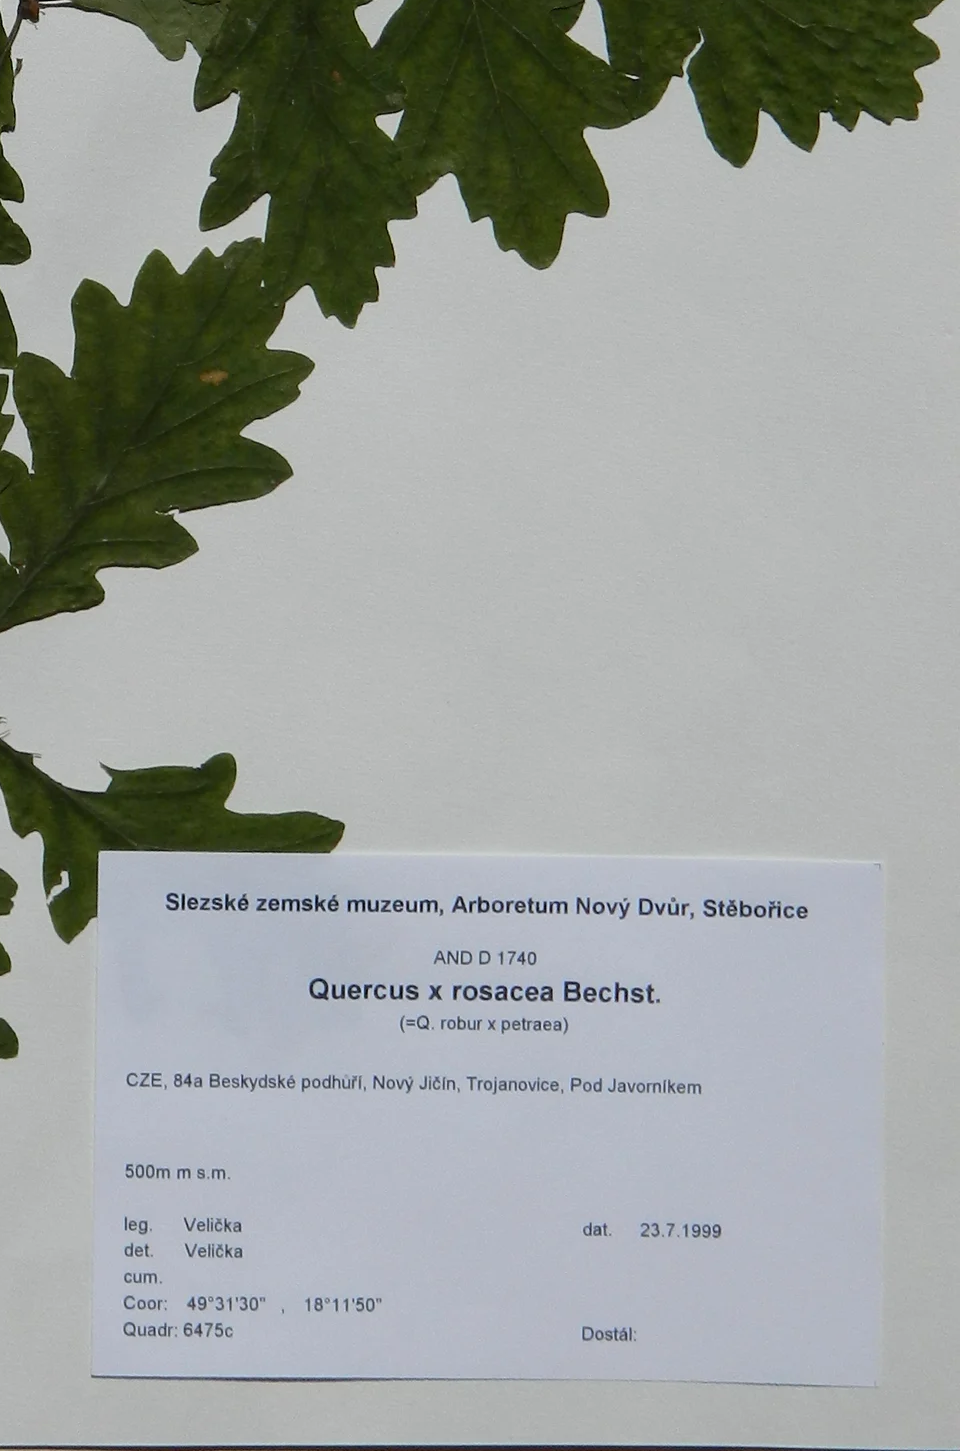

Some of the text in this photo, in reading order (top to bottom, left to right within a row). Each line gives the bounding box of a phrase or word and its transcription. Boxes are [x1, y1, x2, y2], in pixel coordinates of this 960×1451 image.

[165, 892, 809, 920] Slezské zemské muzeum, Arboretum Nový Dvůr, Stěbořice
[433, 950, 538, 966] AND D 1740
[308, 977, 662, 1005] Quercus x rosacea Bechst.
[399, 1014, 569, 1035] (=Q. robur x petraea)
[126, 1072, 168, 1090] CZE,
[173, 1072, 203, 1089] 84a
[209, 1073, 296, 1093] Beskydské
[372, 1075, 414, 1094] Nový
[418, 1075, 461, 1094] Jičín,
[466, 1076, 565, 1095] Trojanovice,
[570, 1077, 603, 1093] Pod
[607, 1078, 703, 1095] Javorníkem
[125, 1163, 232, 1180] 500m m s.m.
[124, 1216, 243, 1235] leg. Velička
[582, 1221, 722, 1239] dat. 23.7.1999
[124, 1242, 244, 1259] det. Velička
[123, 1271, 163, 1285] cum.
[123, 1295, 168, 1311] Coor:
[123, 1321, 234, 1338] Quadr: 6475c
[581, 1325, 638, 1342] Dostál:
